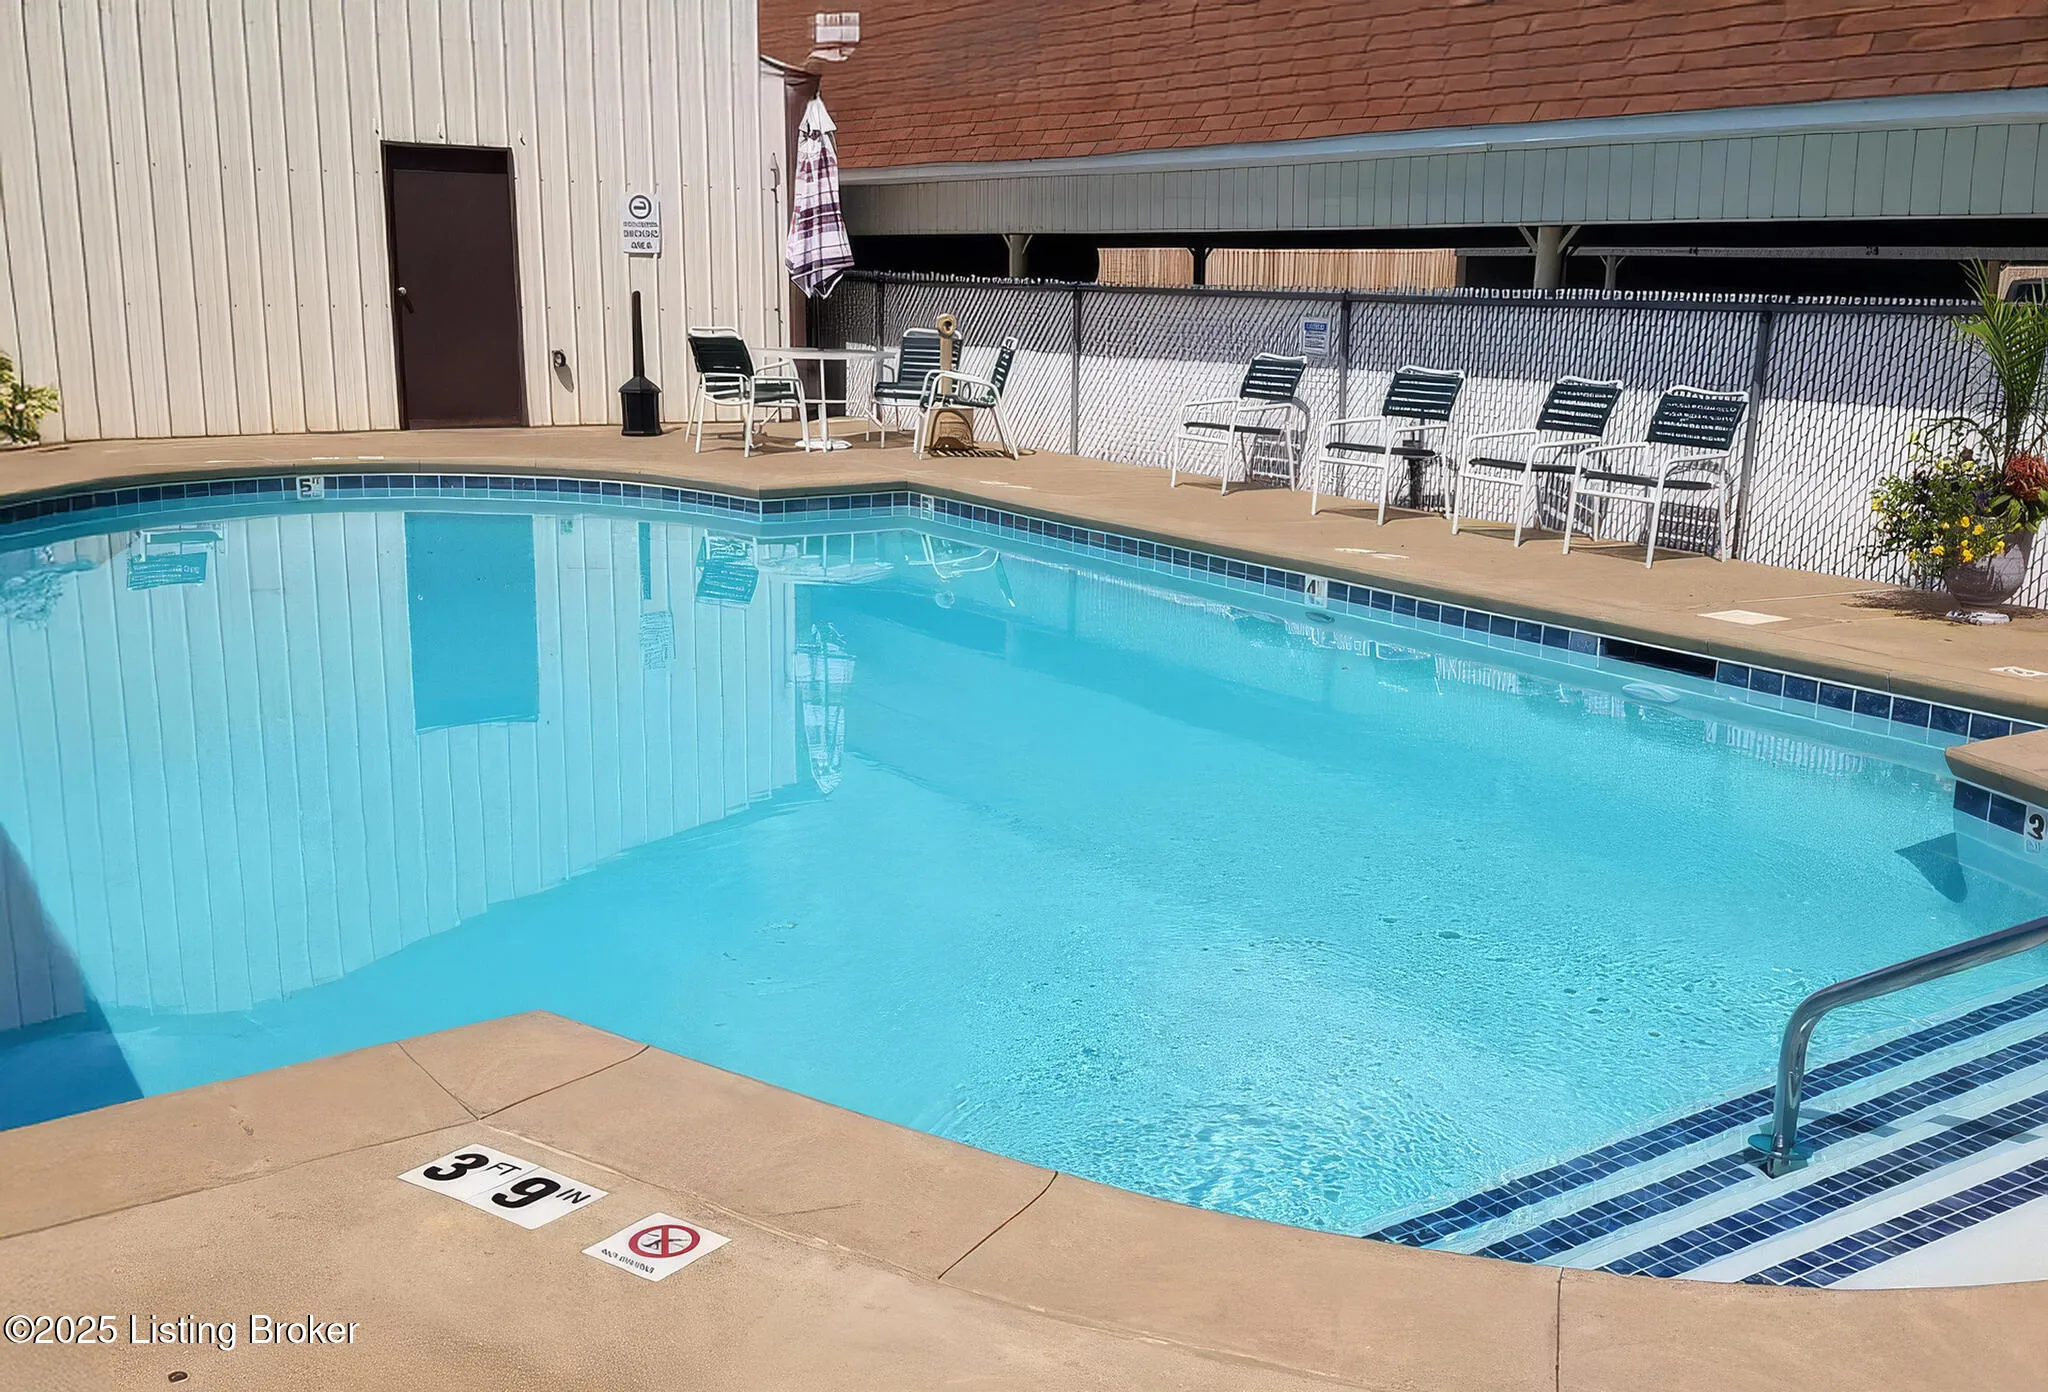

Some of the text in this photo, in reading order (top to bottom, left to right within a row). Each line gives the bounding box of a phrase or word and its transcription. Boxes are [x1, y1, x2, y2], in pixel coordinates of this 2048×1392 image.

[423, 1153, 591, 1209] 3 FT 9 IN
